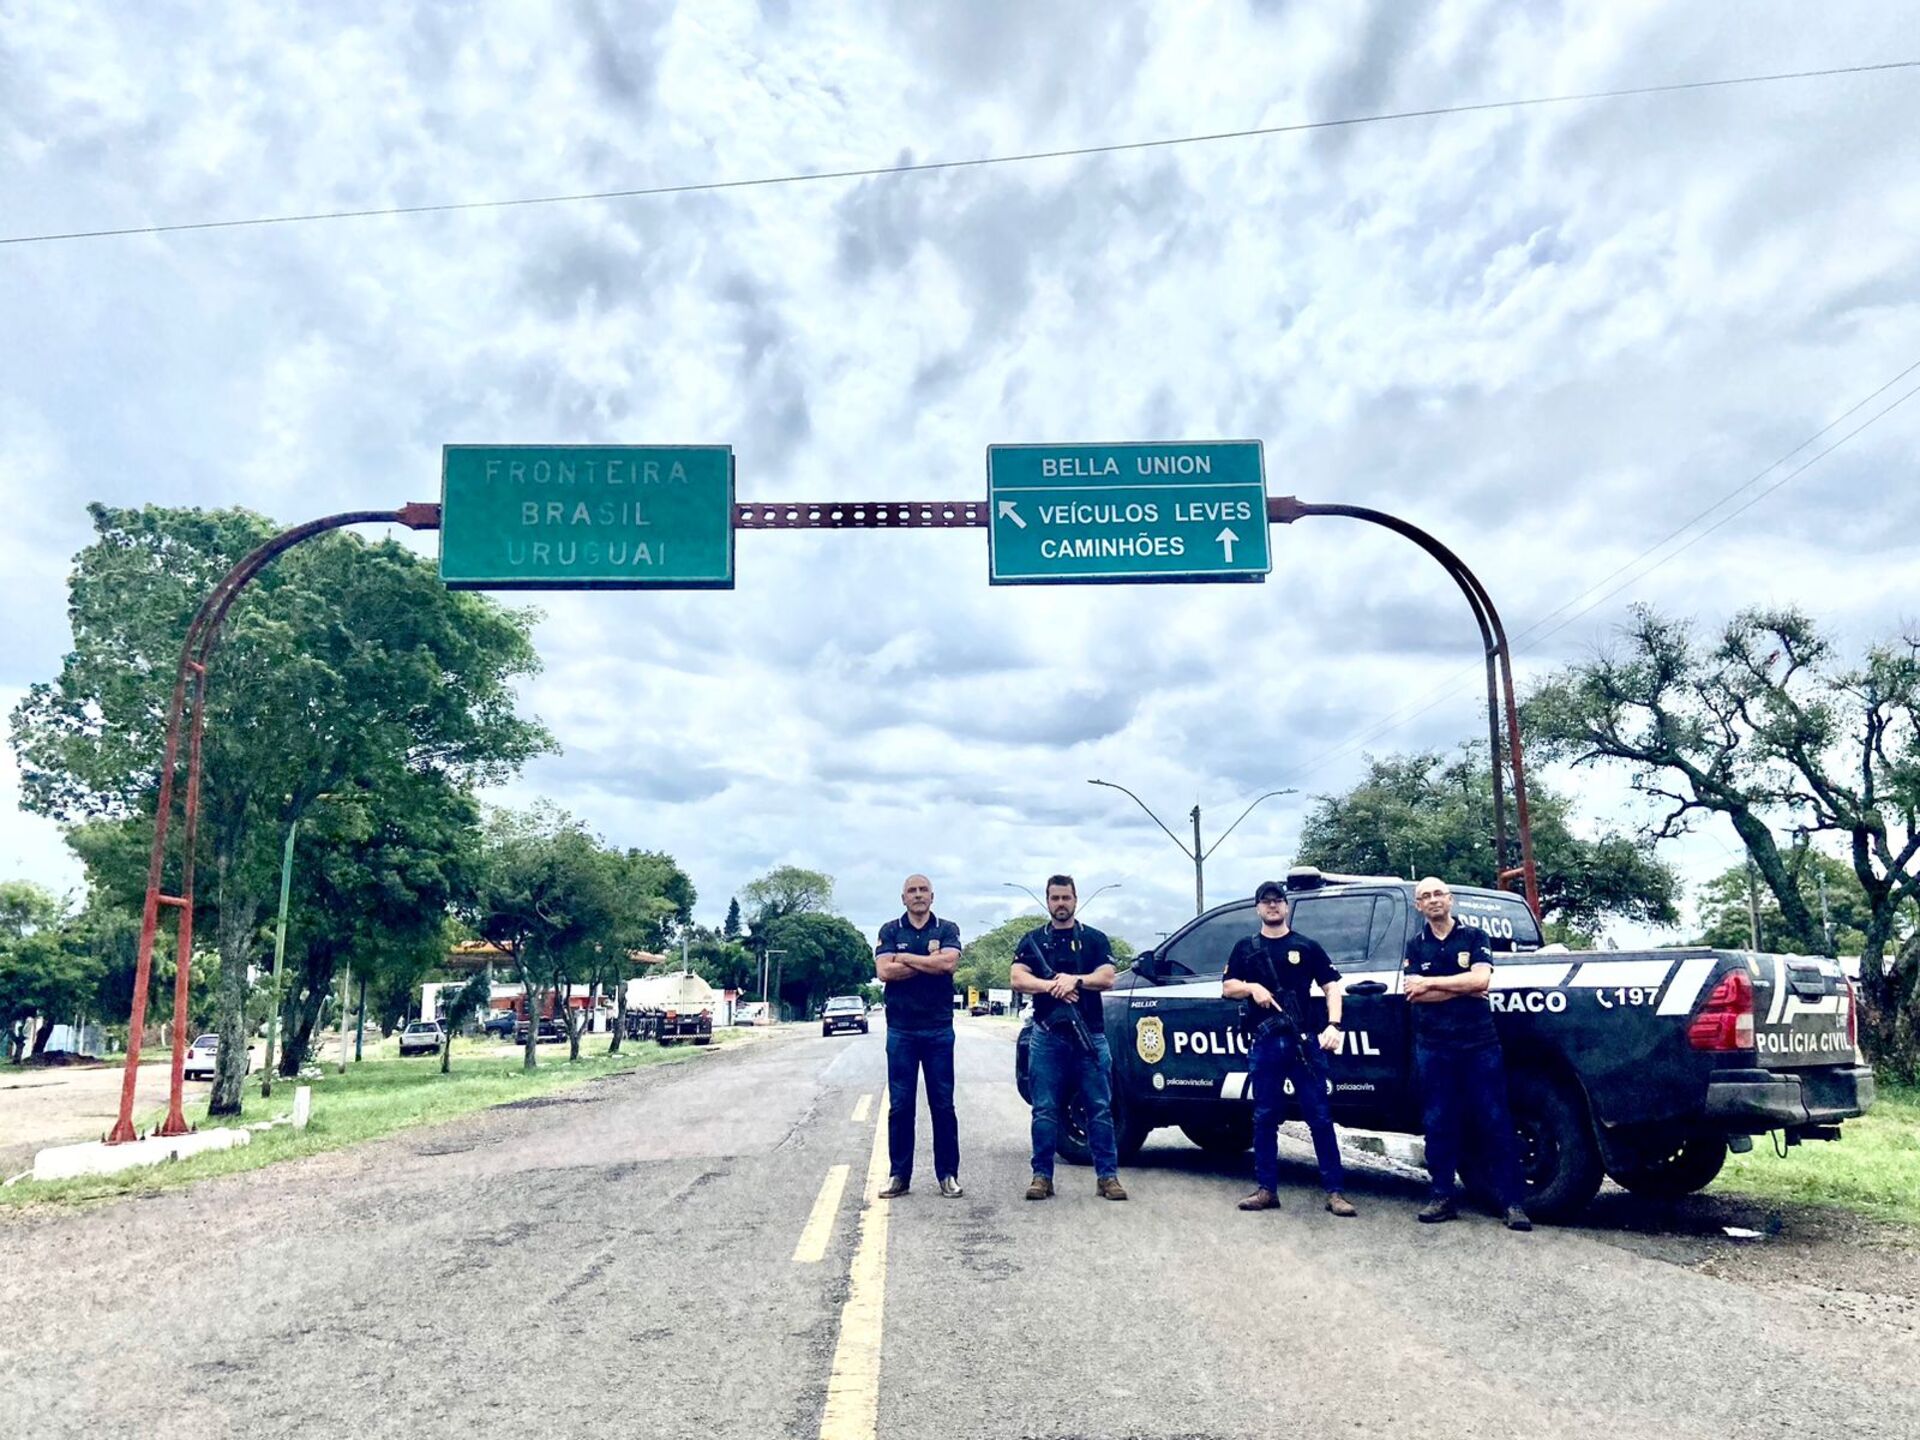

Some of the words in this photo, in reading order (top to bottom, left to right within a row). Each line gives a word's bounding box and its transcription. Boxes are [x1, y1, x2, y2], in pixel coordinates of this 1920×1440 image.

[485, 460, 689, 484] FRONTEIRA
[1042, 457, 1120, 477] BELLA
[1137, 455, 1212, 475] UNION
[522, 501, 651, 526] BRASIL
[1038, 501, 1159, 524] VEÍCULOS
[1175, 501, 1251, 522] LEVES
[508, 541, 665, 566] URUGUAI
[1041, 532, 1185, 558] CAMINHÕES
[1131, 1000, 1158, 1008] HILUX
[1488, 991, 1567, 1013] RACO
[1614, 987, 1659, 1005] 197
[1173, 1026, 1253, 1055] POLÍC
[1756, 1028, 1818, 1053] POLÍCIA
[1820, 1032, 1852, 1051] CIVIL
